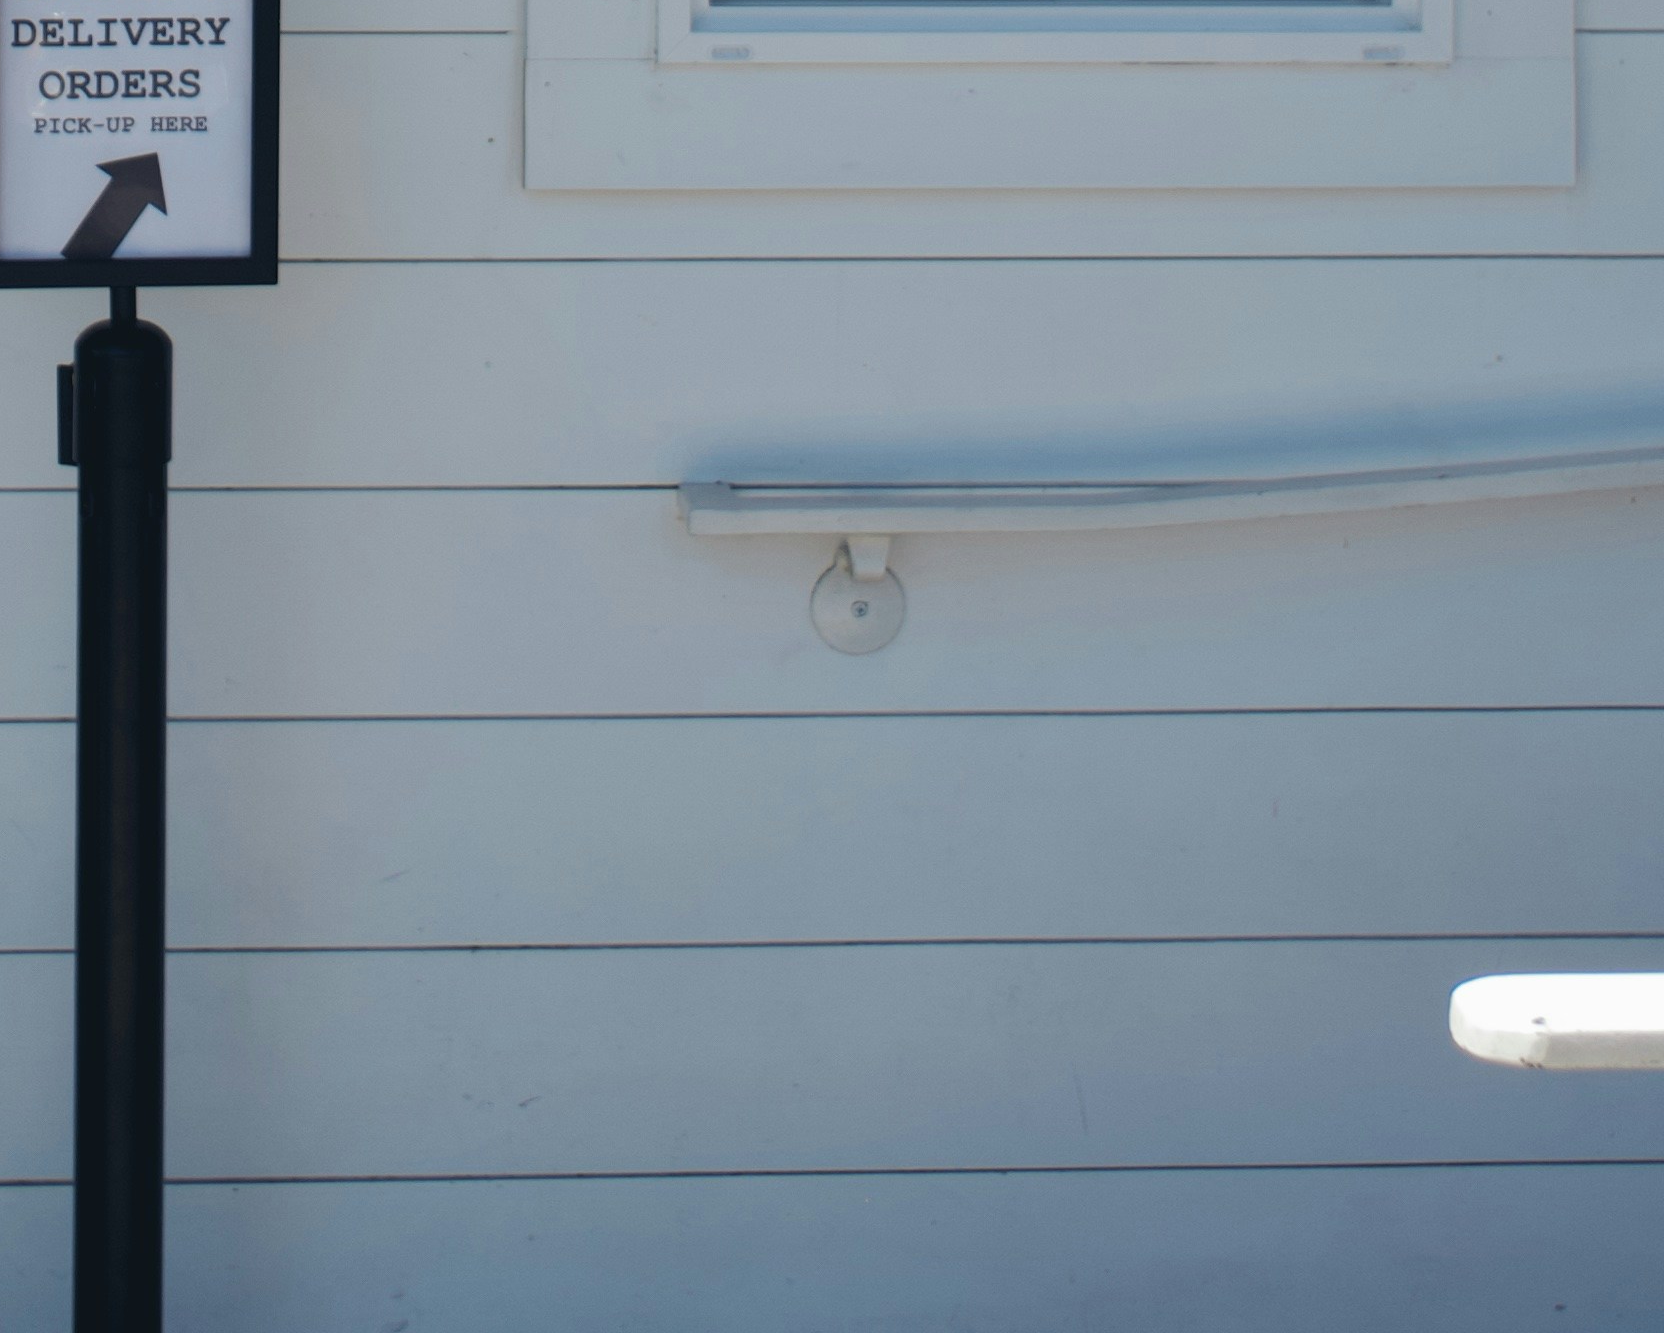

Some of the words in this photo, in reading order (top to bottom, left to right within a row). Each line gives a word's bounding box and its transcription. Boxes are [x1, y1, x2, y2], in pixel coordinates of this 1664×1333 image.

[10, 16, 231, 48] DELIVERY
[38, 70, 201, 99] ORDERS
[33, 116, 136, 134] PICK-UP
[150, 115, 209, 132] HERE
